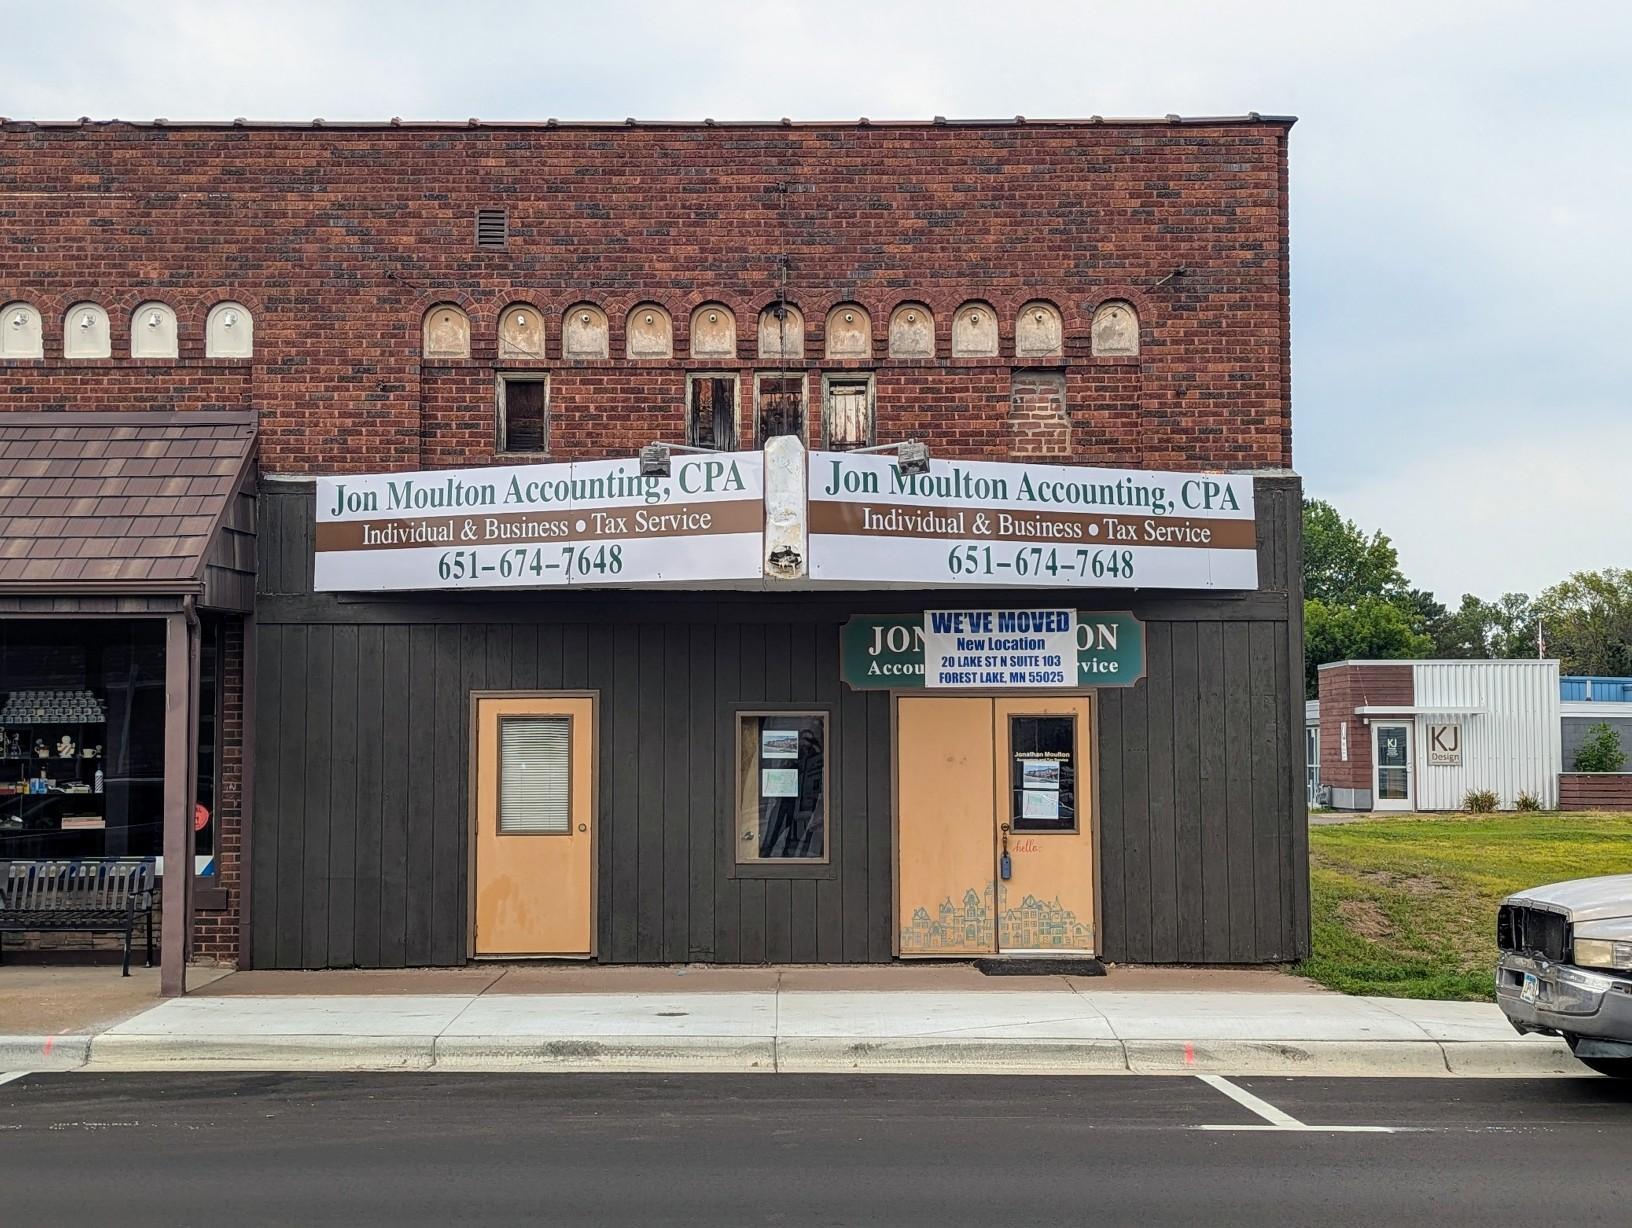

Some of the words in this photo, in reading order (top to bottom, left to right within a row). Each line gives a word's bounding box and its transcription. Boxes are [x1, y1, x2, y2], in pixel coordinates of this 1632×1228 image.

[331, 484, 378, 517] Jon
[386, 478, 497, 511] Moulton
[503, 466, 670, 504] Accounting,
[679, 459, 746, 495] CPA
[825, 460, 879, 496] Jon
[888, 464, 1008, 500] Moulton
[1016, 471, 1175, 516] Accounting,
[1181, 479, 1240, 511] CPA
[362, 519, 454, 545] Individual
[460, 518, 478, 540] &
[484, 516, 569, 539] Business
[591, 512, 628, 534] Tax
[635, 507, 712, 533] Service
[863, 507, 965, 534] Individual
[972, 512, 992, 534] &
[998, 513, 1082, 538] Business
[1103, 518, 1138, 541] Tax
[1144, 520, 1211, 543] Service
[438, 544, 623, 580] 651-674-7648
[948, 544, 1134, 579] 651-674-7648
[931, 611, 993, 633] WE'VE
[998, 610, 1070, 633] MOVED
[956, 637, 985, 651] New
[988, 636, 1045, 651] Location
[1076, 623, 1119, 650] ON
[867, 660, 925, 675] Accou
[1077, 657, 1119, 673] vice
[941, 656, 955, 667] 20
[958, 656, 982, 667] LAKE
[984, 656, 998, 667] ST
[1000, 656, 1007, 667] N
[1009, 655, 1039, 667] SUITE
[1042, 655, 1061, 667] 103
[939, 672, 977, 683] FOREST
[980, 671, 1007, 684] LAKE,
[1009, 671, 1026, 683] MN
[1028, 671, 1064, 683] 55025
[1387, 738, 1397, 748] KJ
[1431, 726, 1458, 751] KJ
[1431, 752, 1460, 763] Design
